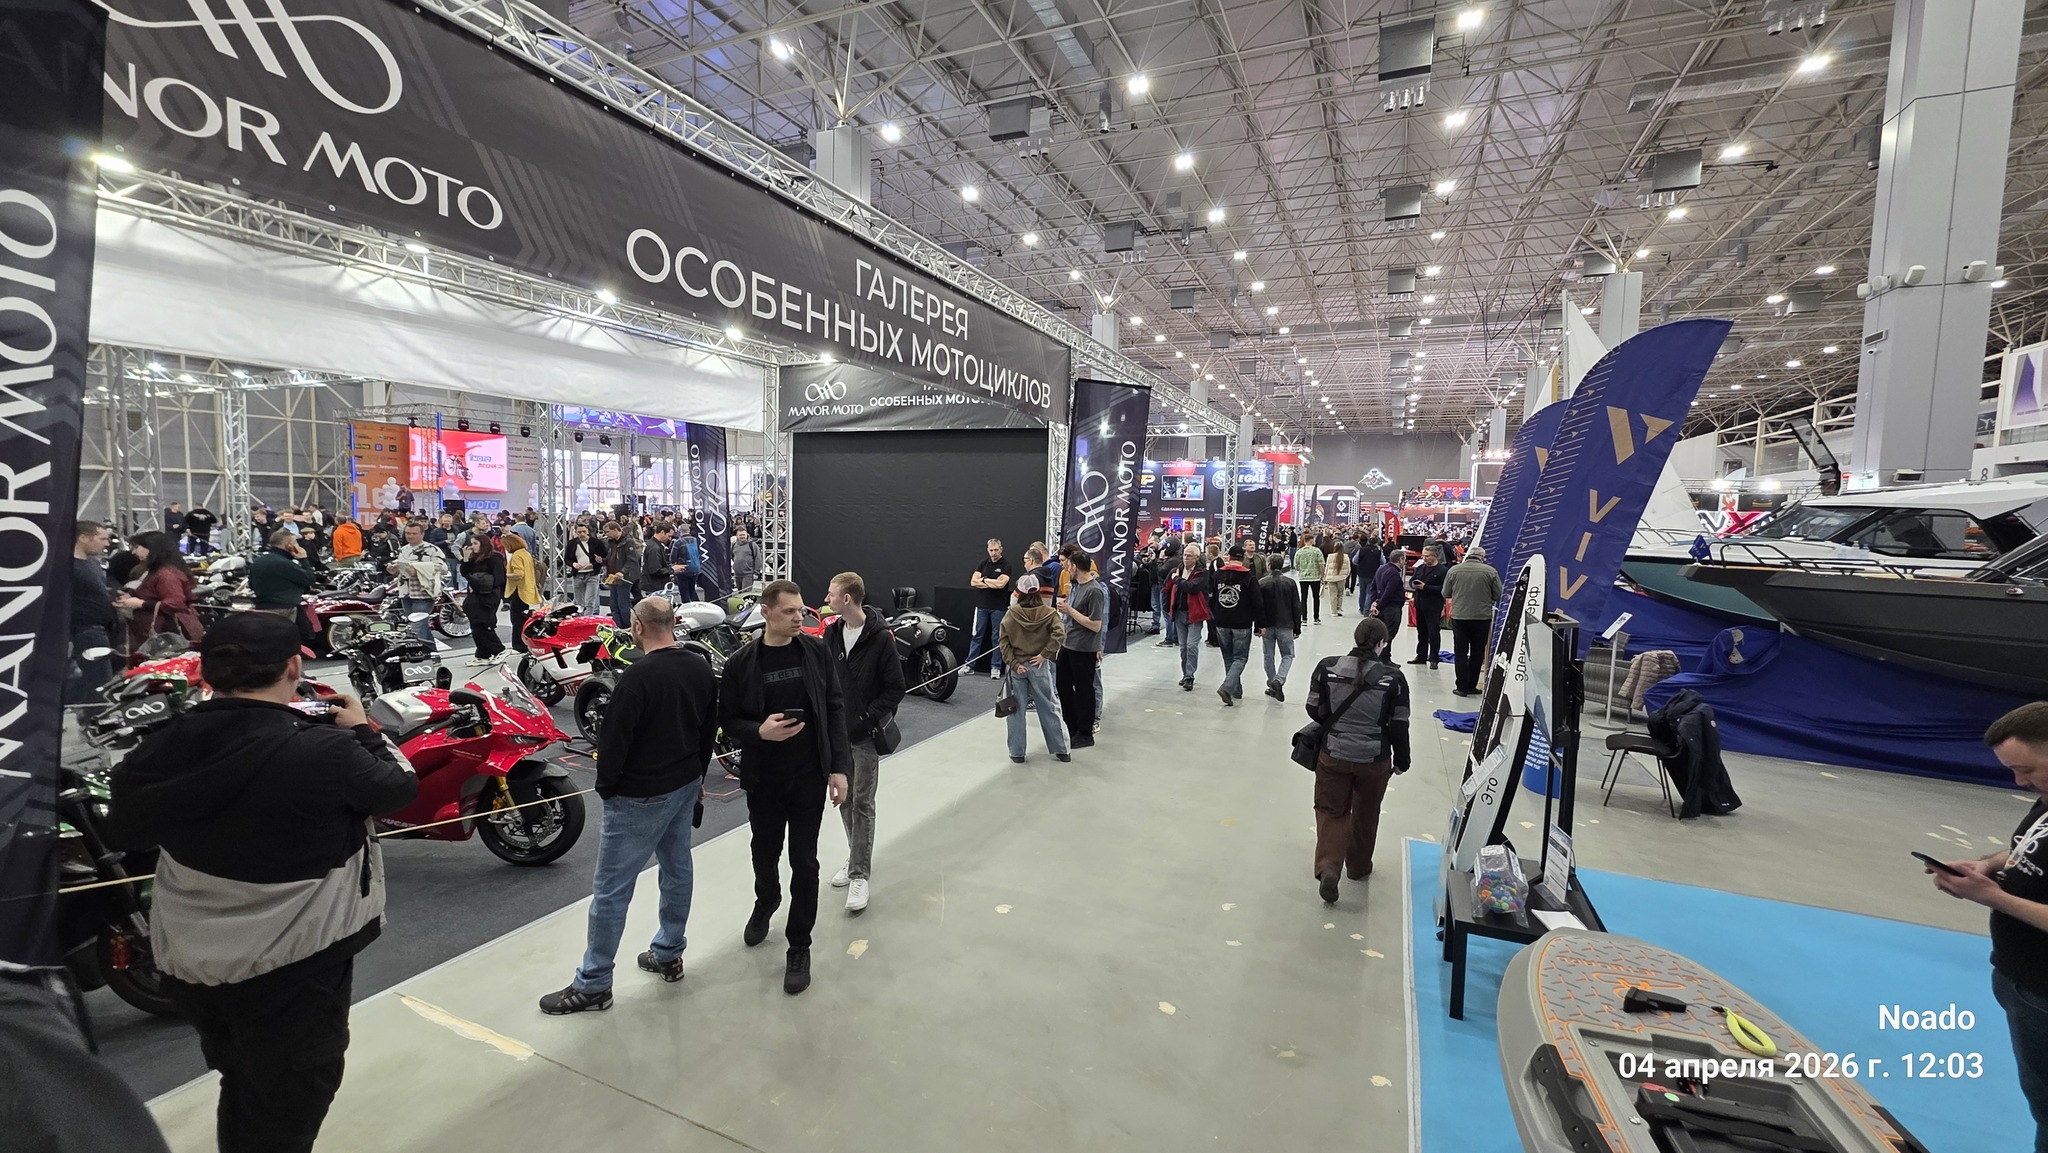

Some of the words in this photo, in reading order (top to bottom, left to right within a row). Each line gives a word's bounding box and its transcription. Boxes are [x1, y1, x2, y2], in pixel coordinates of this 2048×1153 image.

[303, 131, 502, 230] MOTO
[626, 228, 903, 363] ОСОБЕННЫХ
[911, 338, 1051, 409] МОТОЦИКЛОВ
[856, 258, 969, 341] ГАЛЕРЕЯ
[788, 405, 829, 417] MANOR
[831, 404, 863, 415] MOTO
[869, 394, 943, 407] ОСОБЕННЫХ
[1117, 440, 1137, 504] MOTO
[1980, 467, 1988, 481] 8
[1109, 507, 1131, 589] MANOR
[1258, 520, 1269, 550] SEGAL
[1559, 488, 1622, 601] VIV
[764, 672, 775, 682] ET
[778, 668, 801, 680] BETT
[1481, 777, 1499, 806] Это
